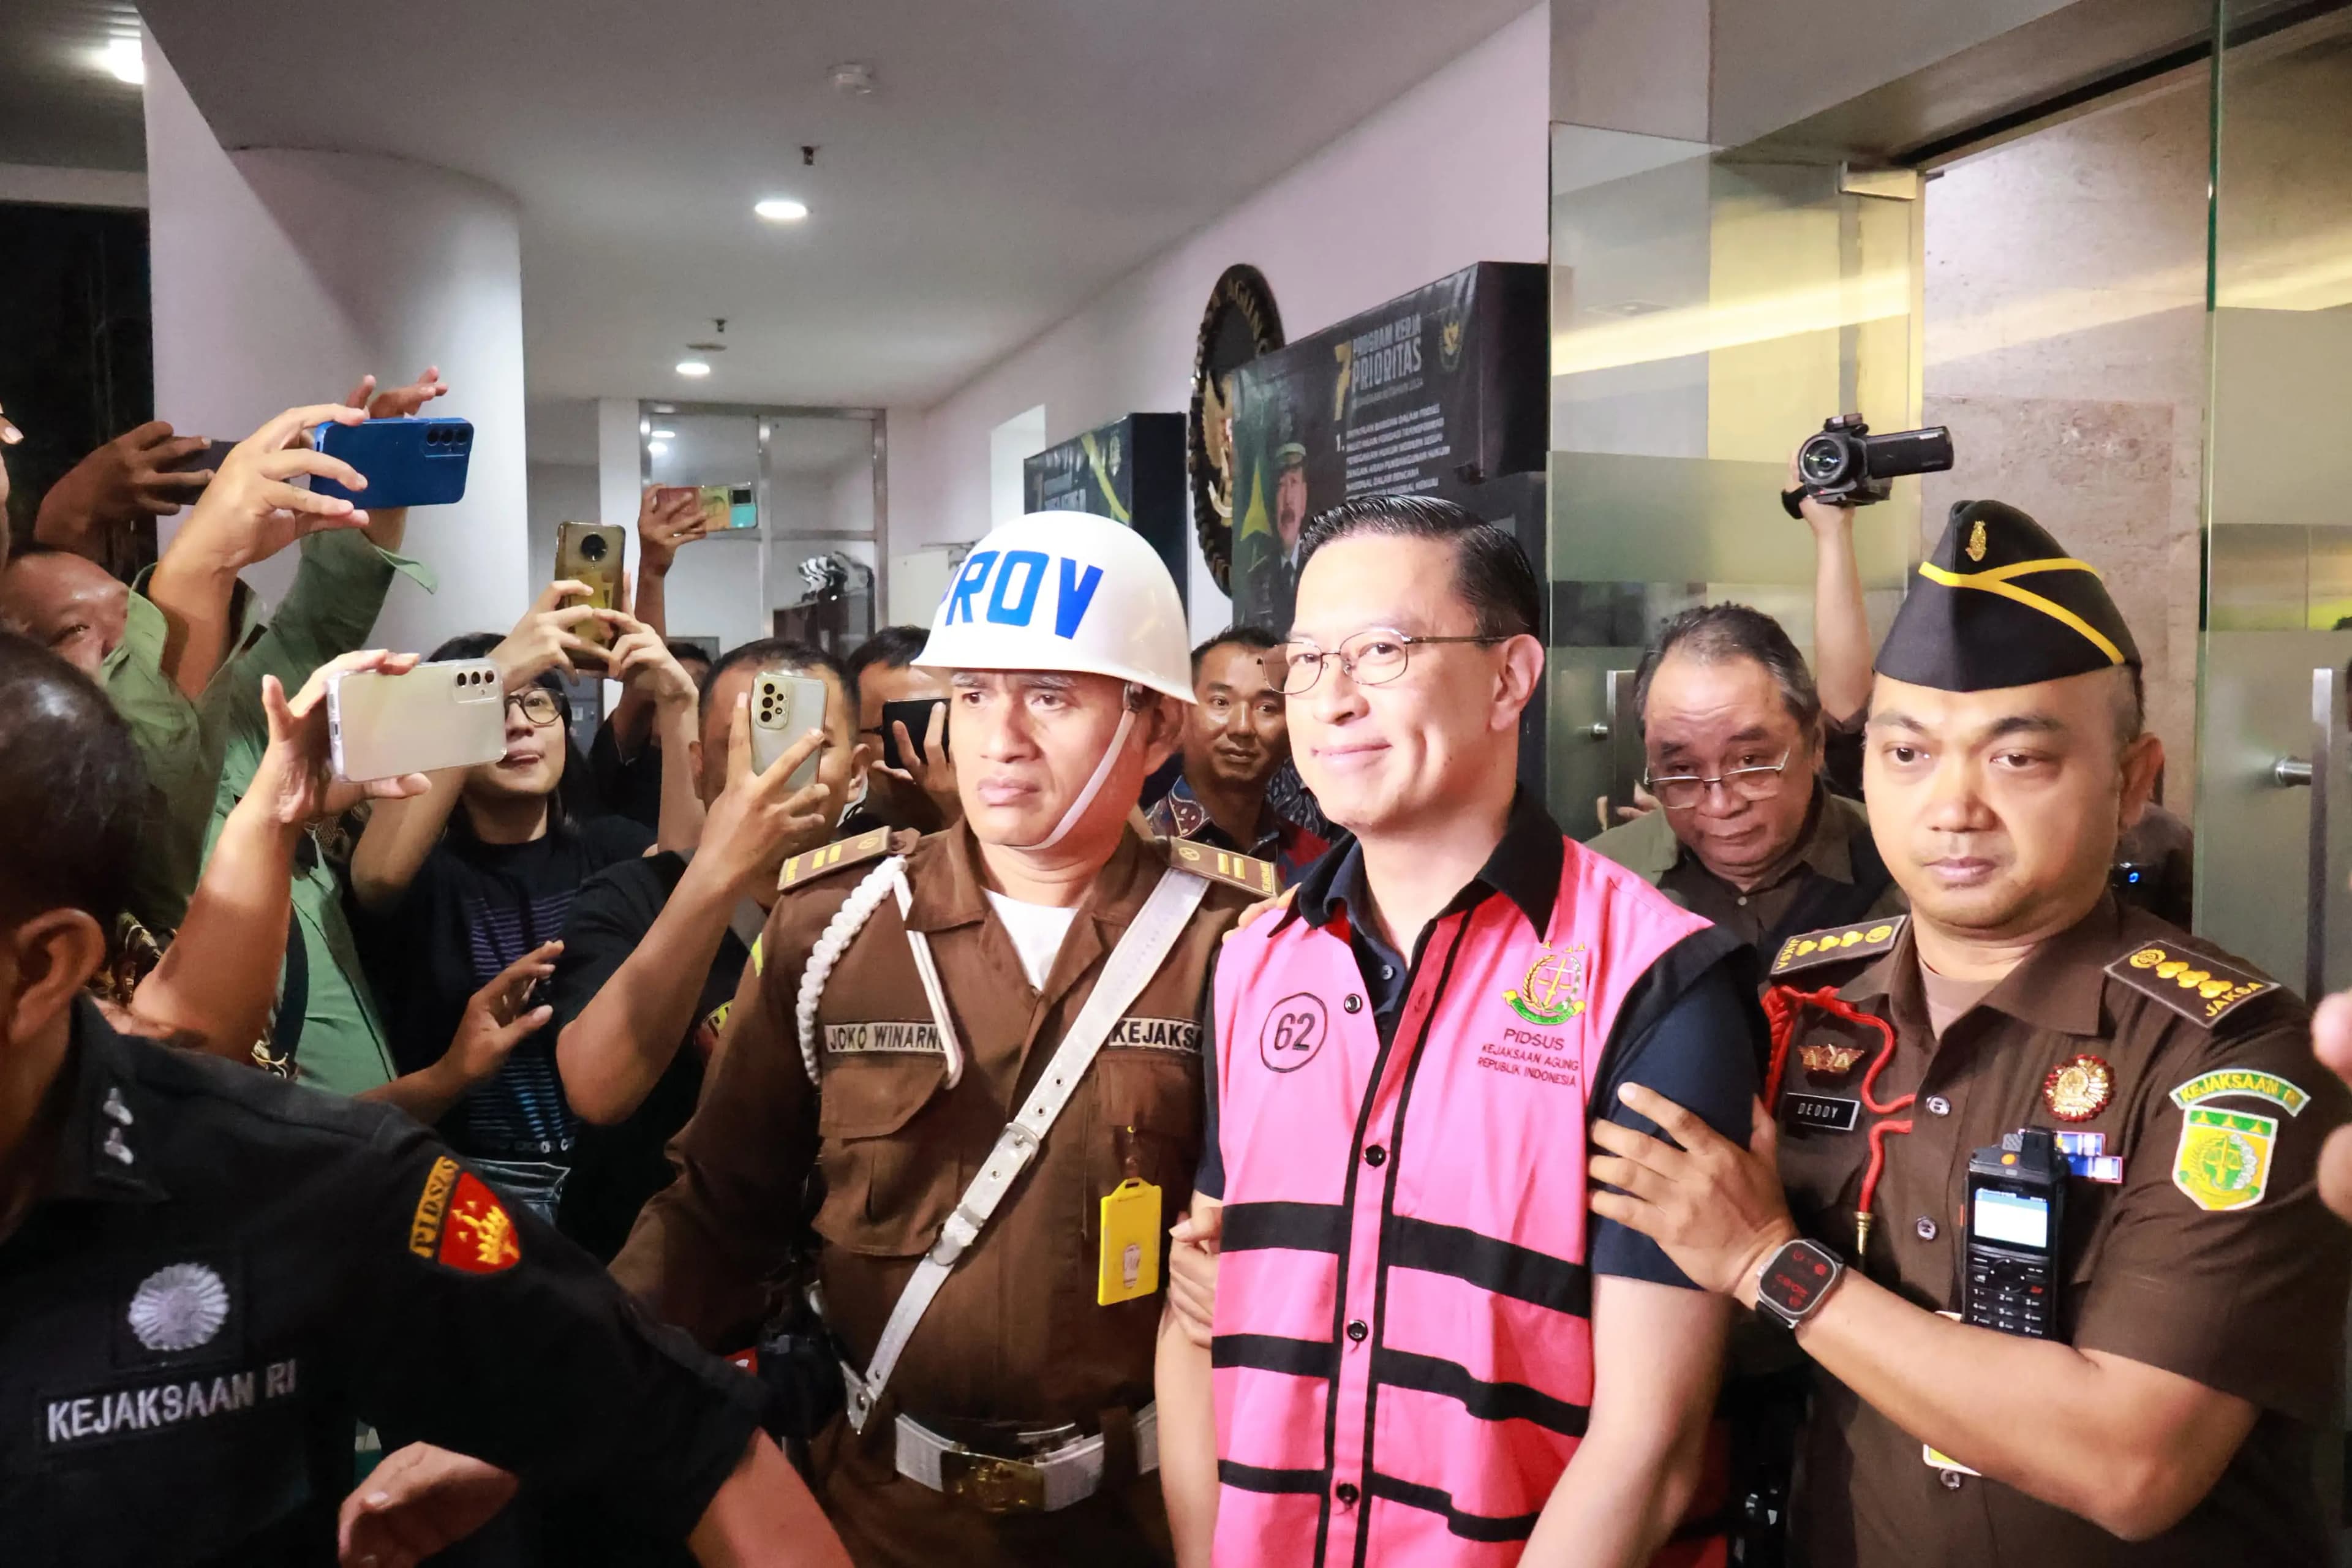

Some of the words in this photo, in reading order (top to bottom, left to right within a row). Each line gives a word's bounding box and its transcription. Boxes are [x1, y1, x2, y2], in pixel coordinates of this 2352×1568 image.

[1334, 340, 1352, 421] 7
[1352, 337, 1422, 393] PRIORITAS
[941, 550, 1104, 640] ROV
[1776, 939, 1801, 970] JAKSA
[2206, 982, 2264, 1017] JAKSA
[831, 1026, 867, 1050] JOKO
[1274, 1012, 1316, 1051] 62
[1504, 1028, 1565, 1051] PIDSUS
[1477, 1057, 1520, 1076] REPUBLIK
[1524, 1067, 1577, 1087] INDONESIA
[1482, 1043, 1542, 1064] KEJAKSAAN
[1544, 1057, 1579, 1071] AGUNG
[2180, 1073, 2279, 1102] KEJAKSAAN
[47, 1371, 255, 1442] KEJAKSAAN
[265, 1359, 297, 1398] RI
